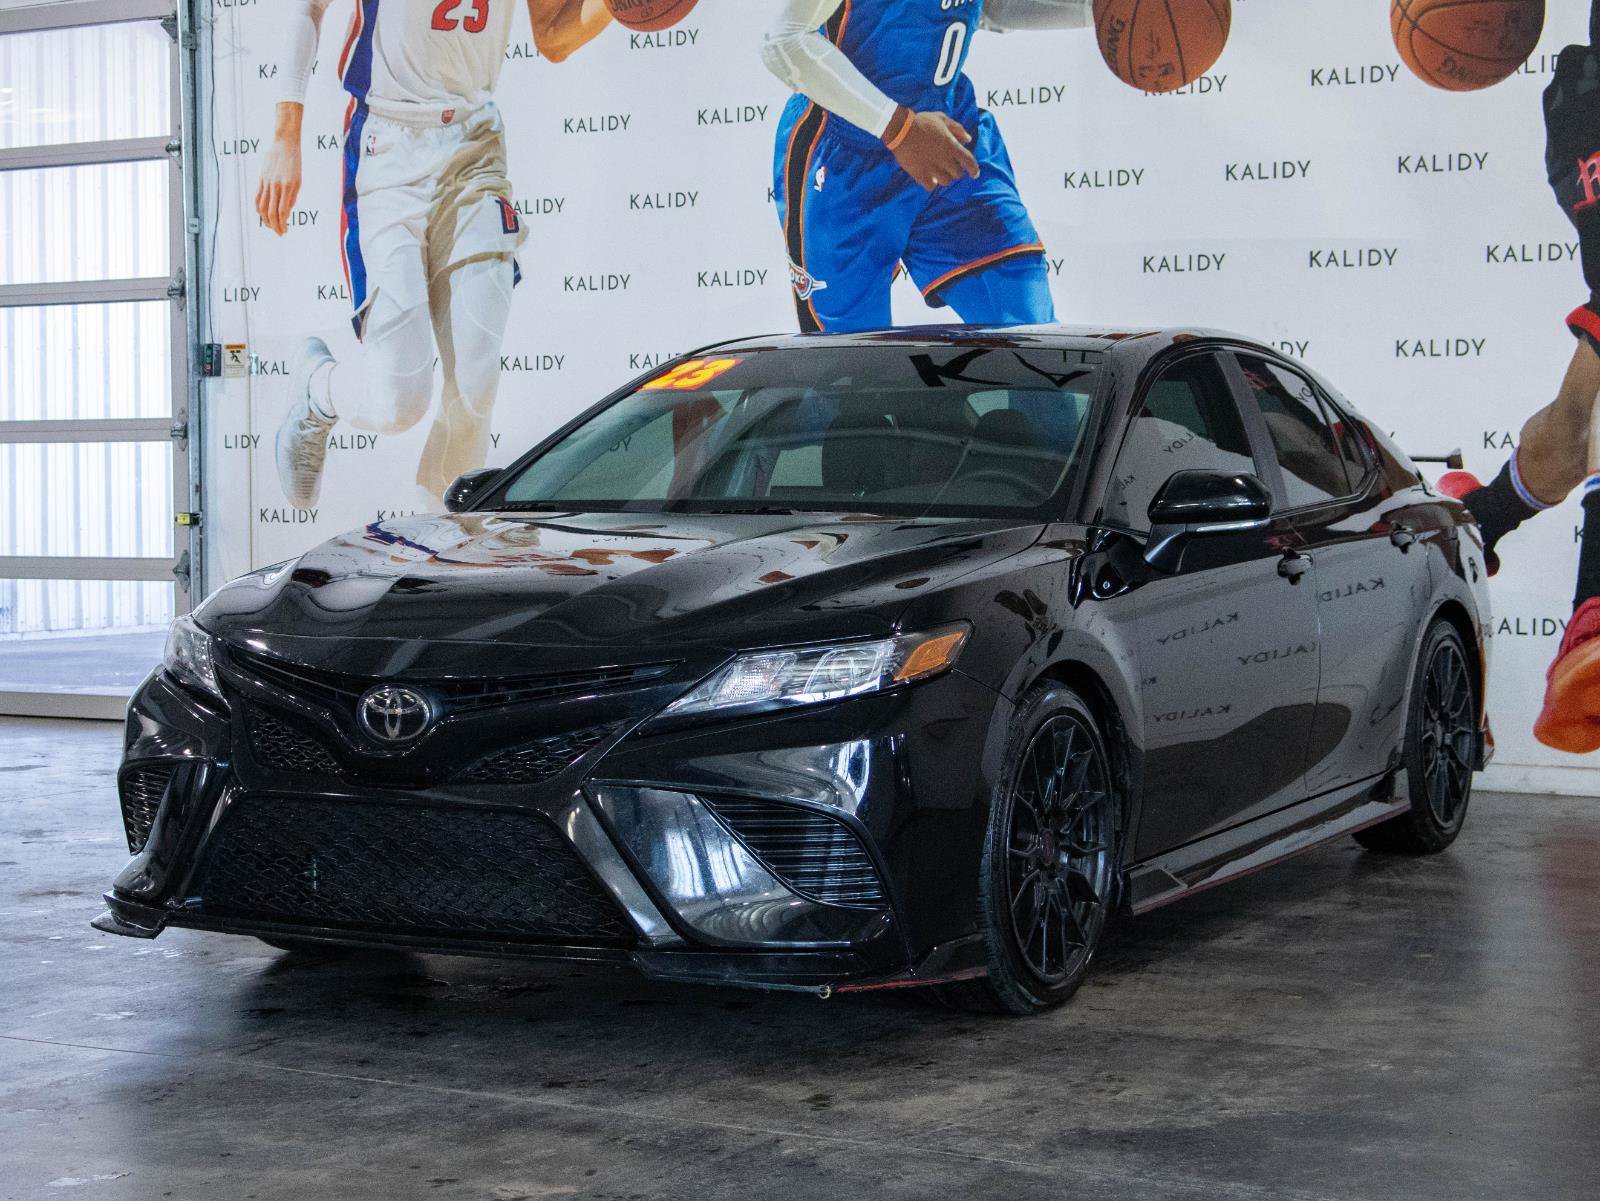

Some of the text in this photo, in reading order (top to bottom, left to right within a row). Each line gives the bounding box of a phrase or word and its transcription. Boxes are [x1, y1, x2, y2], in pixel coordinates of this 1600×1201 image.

[630, 29, 699, 49] KALIDY
[933, 21, 967, 86] 0
[1311, 65, 1399, 86] KALIDY
[987, 86, 1066, 107] KALIDY
[564, 114, 631, 133] KALIDY
[697, 105, 768, 126] KALIDY
[1225, 160, 1311, 181] KALIDY
[1398, 152, 1489, 174] KALIDY
[1064, 169, 1145, 189] KALIDY
[629, 191, 699, 209] KALIDY
[1309, 248, 1398, 268] KALIDY
[1487, 243, 1579, 263] KALIDY
[1143, 254, 1226, 273] KALIDY
[564, 274, 631, 291] KALIDY
[697, 269, 768, 287] KALIDY
[1396, 338, 1486, 357] KALIDY
[500, 354, 565, 371] KALIDY
[259, 508, 319, 523] KALIDY
